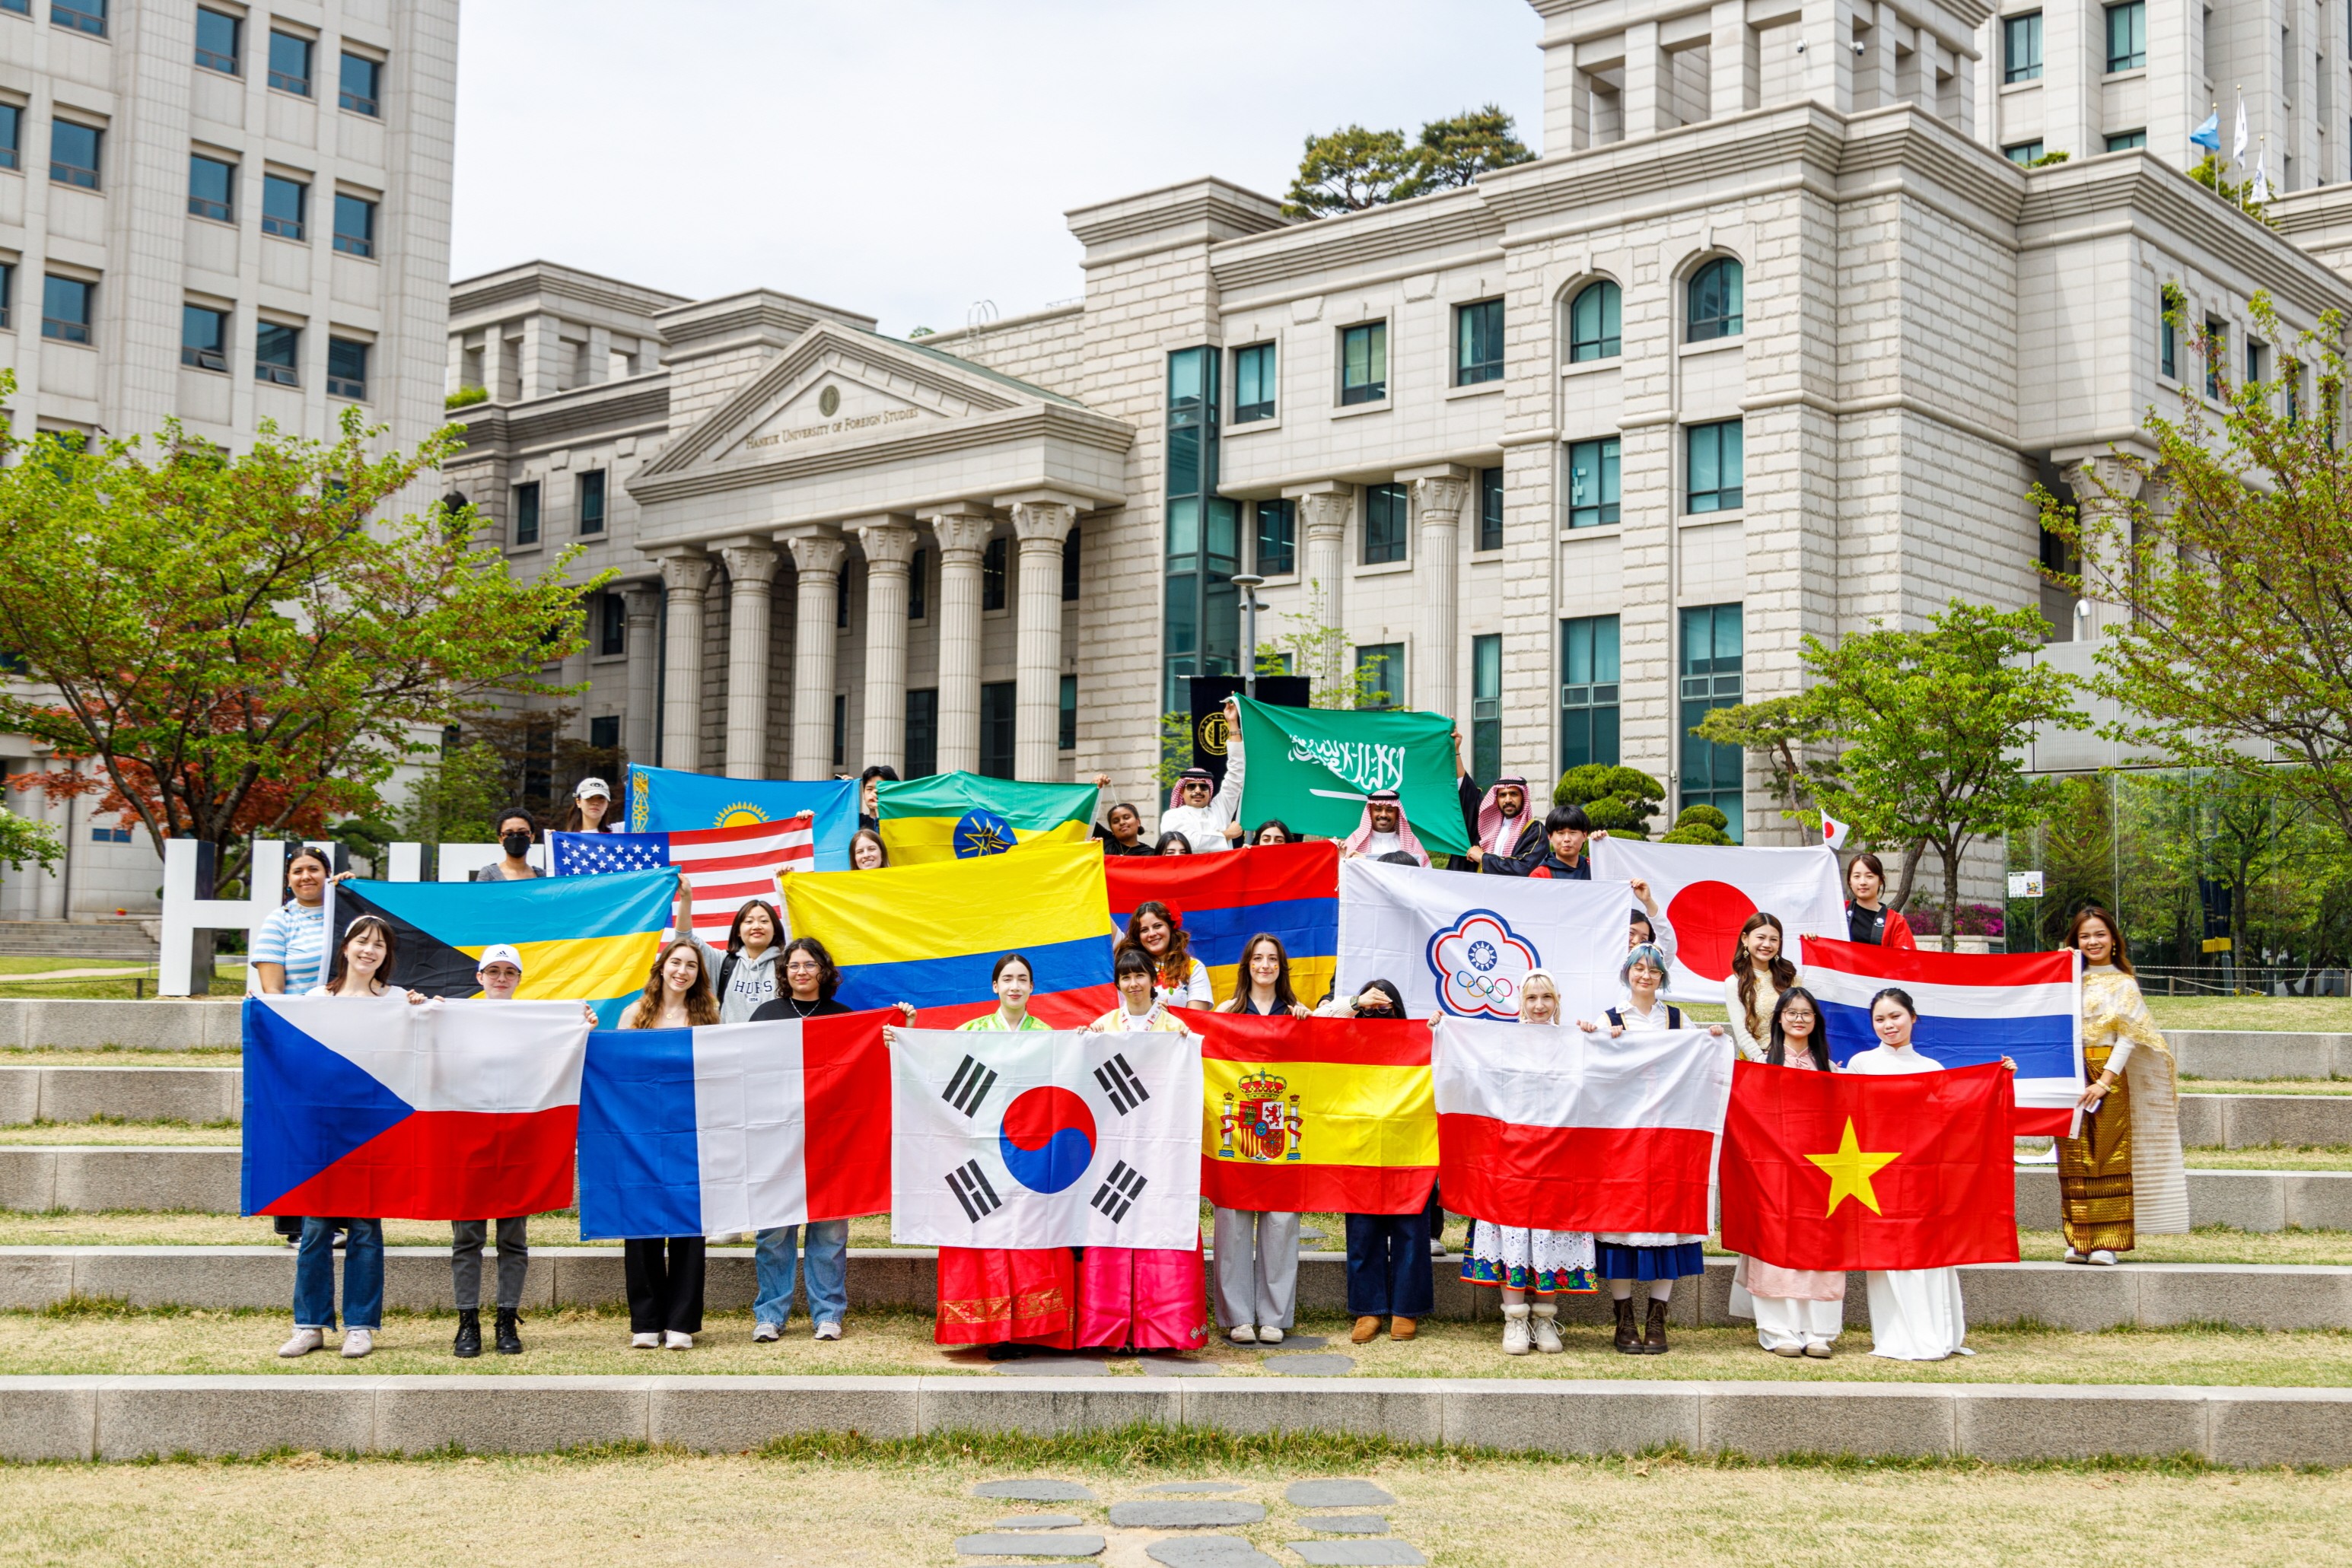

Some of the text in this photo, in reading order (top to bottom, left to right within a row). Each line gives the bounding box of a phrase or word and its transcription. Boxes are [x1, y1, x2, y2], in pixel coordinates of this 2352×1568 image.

[782, 425, 829, 443] UNIVERSITY
[845, 415, 881, 431] FOREIGN
[884, 407, 918, 425] STUDIES
[734, 981, 772, 994] HUFS
